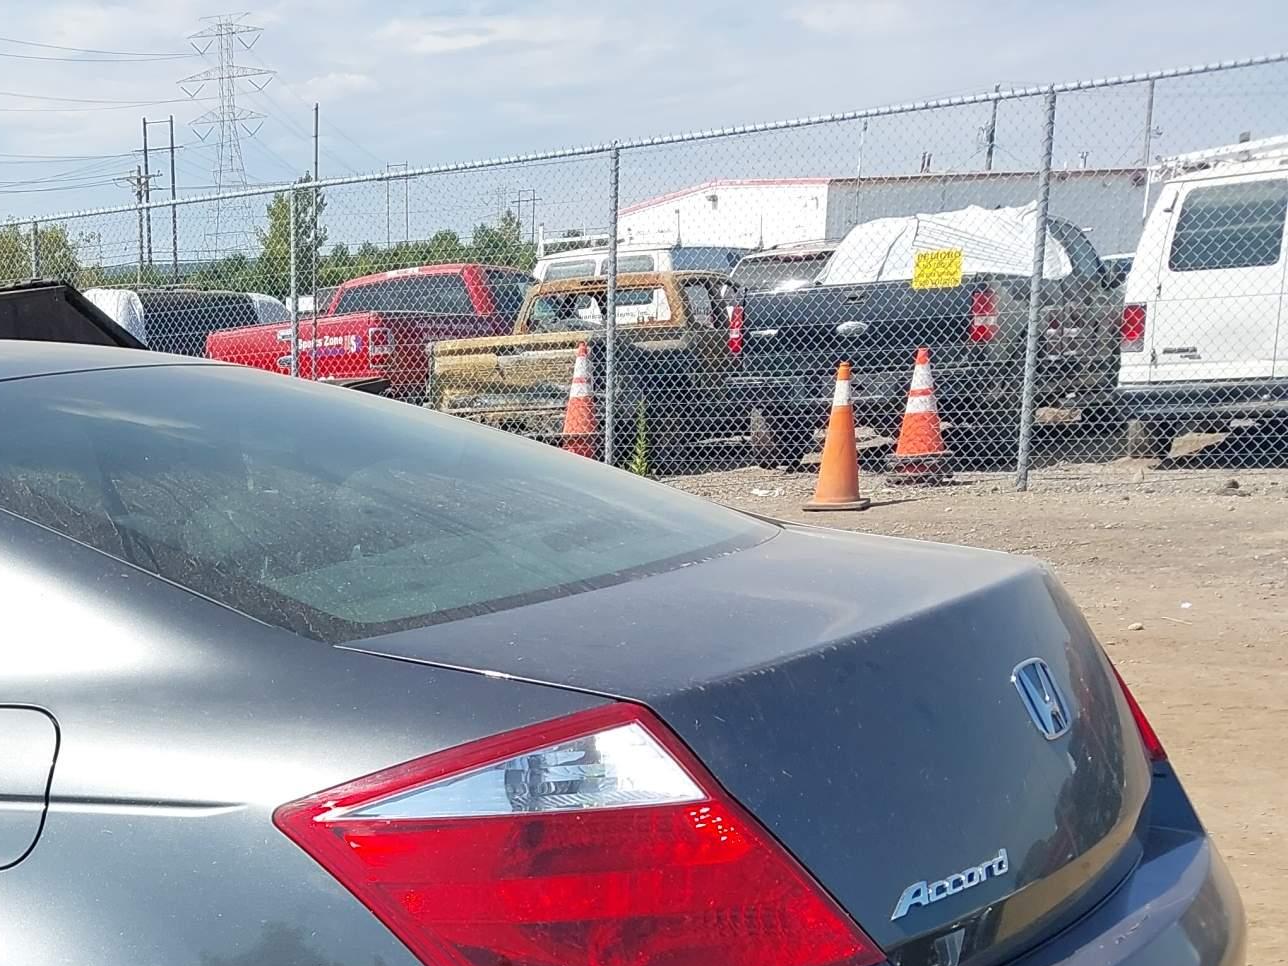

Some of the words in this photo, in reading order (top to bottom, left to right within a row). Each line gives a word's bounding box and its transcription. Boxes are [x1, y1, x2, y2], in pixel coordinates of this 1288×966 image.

[298, 338, 322, 351] Spors
[323, 335, 343, 346] Zone
[891, 848, 1009, 920] Accord
